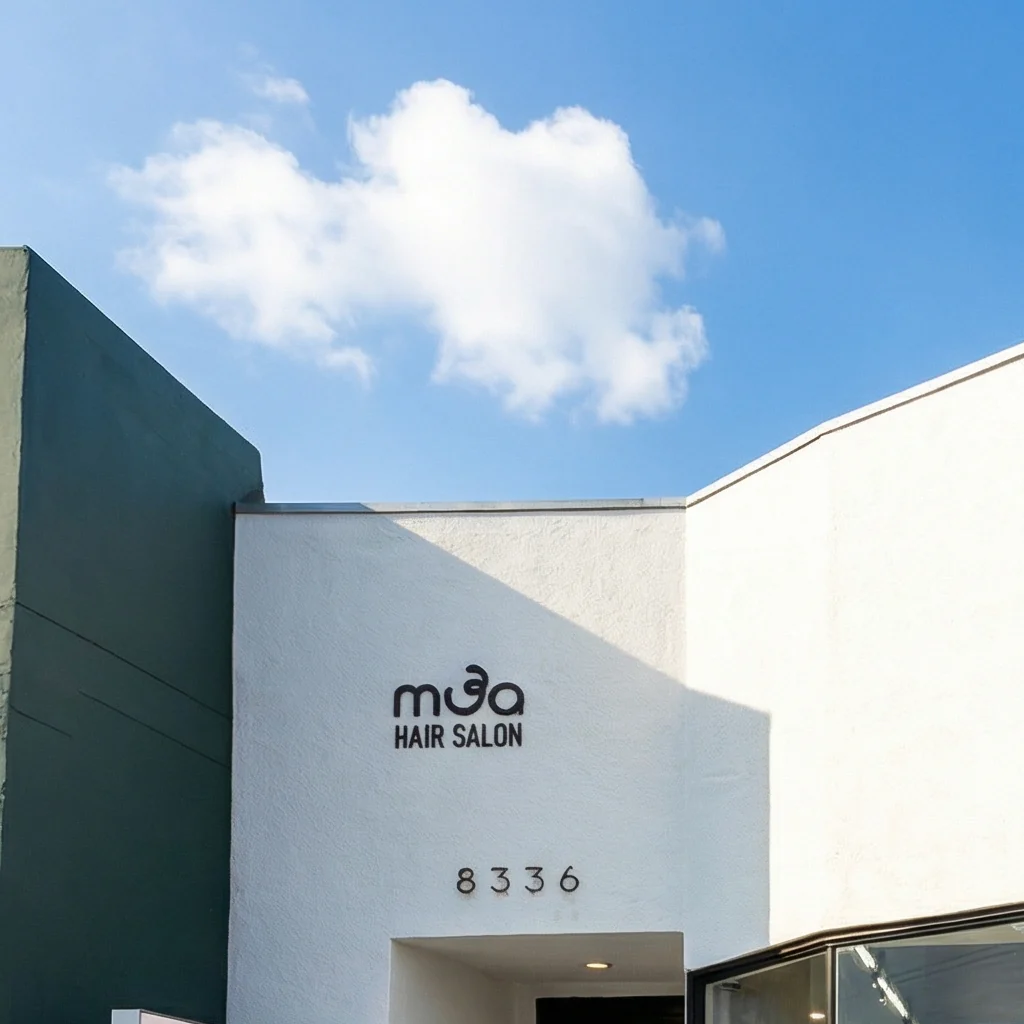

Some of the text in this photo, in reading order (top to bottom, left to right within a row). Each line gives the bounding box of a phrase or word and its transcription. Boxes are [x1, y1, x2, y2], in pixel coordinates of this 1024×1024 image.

[394, 722, 523, 749] HAIR SALON
[456, 865, 580, 895] 8336
